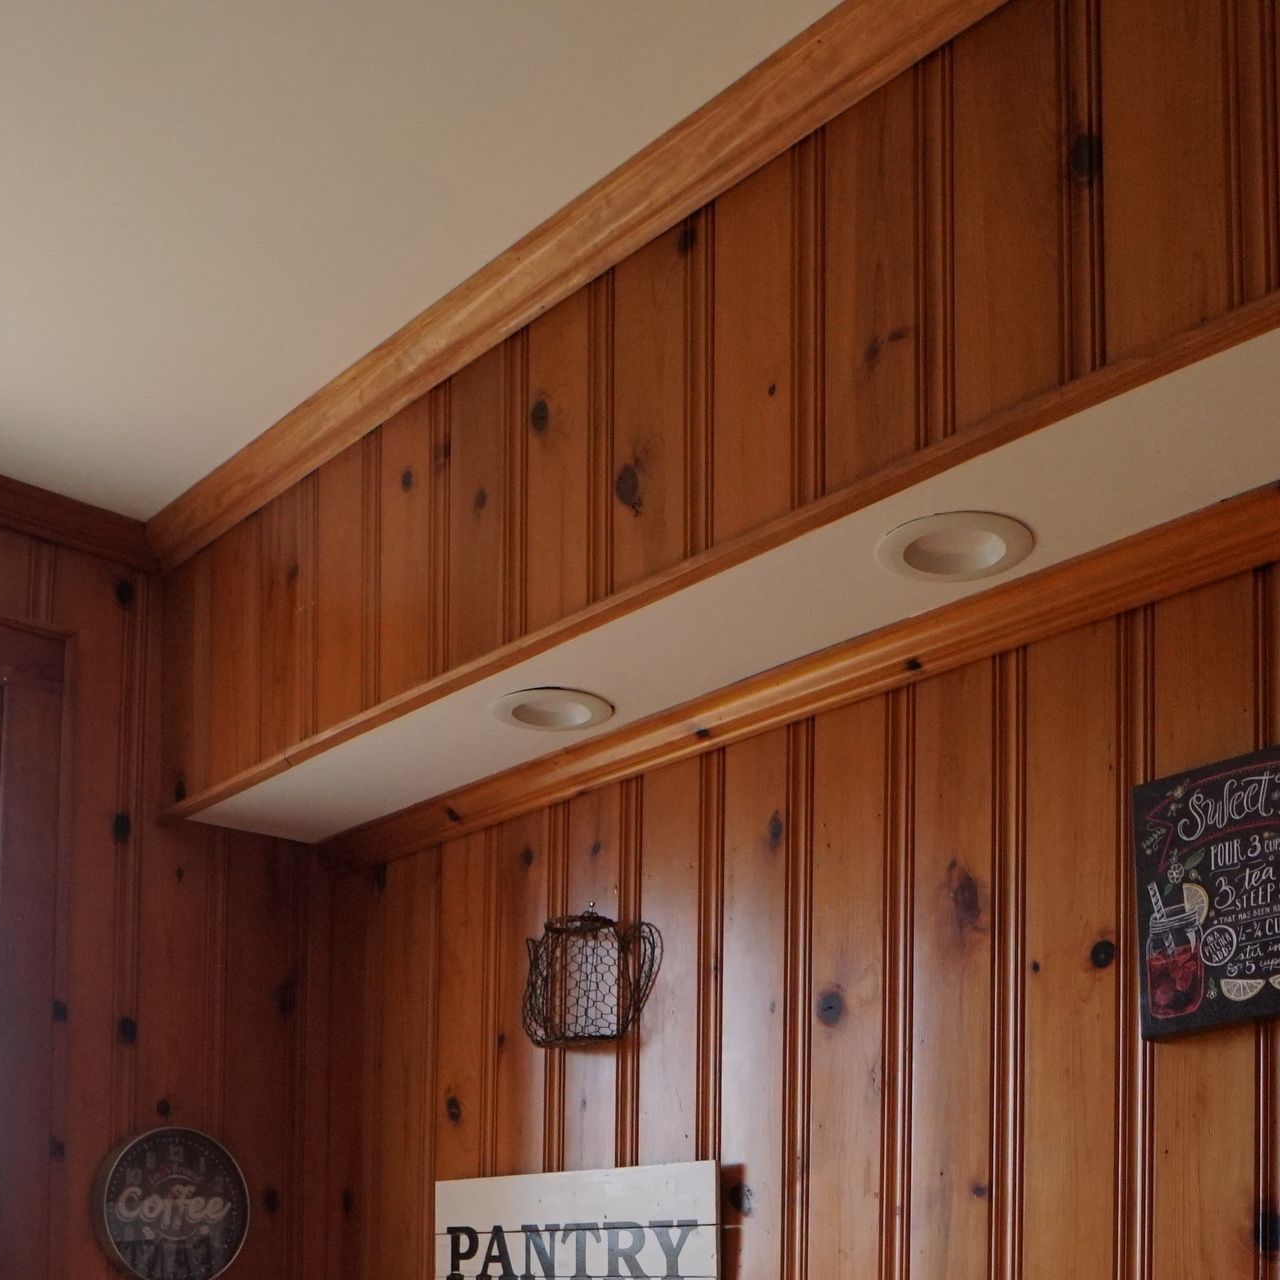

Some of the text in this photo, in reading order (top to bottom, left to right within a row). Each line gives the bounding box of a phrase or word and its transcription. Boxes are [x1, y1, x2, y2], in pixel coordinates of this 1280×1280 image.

[1177, 770, 1275, 841] Sweet
[1210, 838, 1246, 870] POUR
[1247, 834, 1261, 857] 3
[1214, 876, 1236, 909] 3
[1235, 863, 1276, 893] tea
[1235, 882, 1276, 910] STEEP
[1245, 960, 1256, 975] 5
